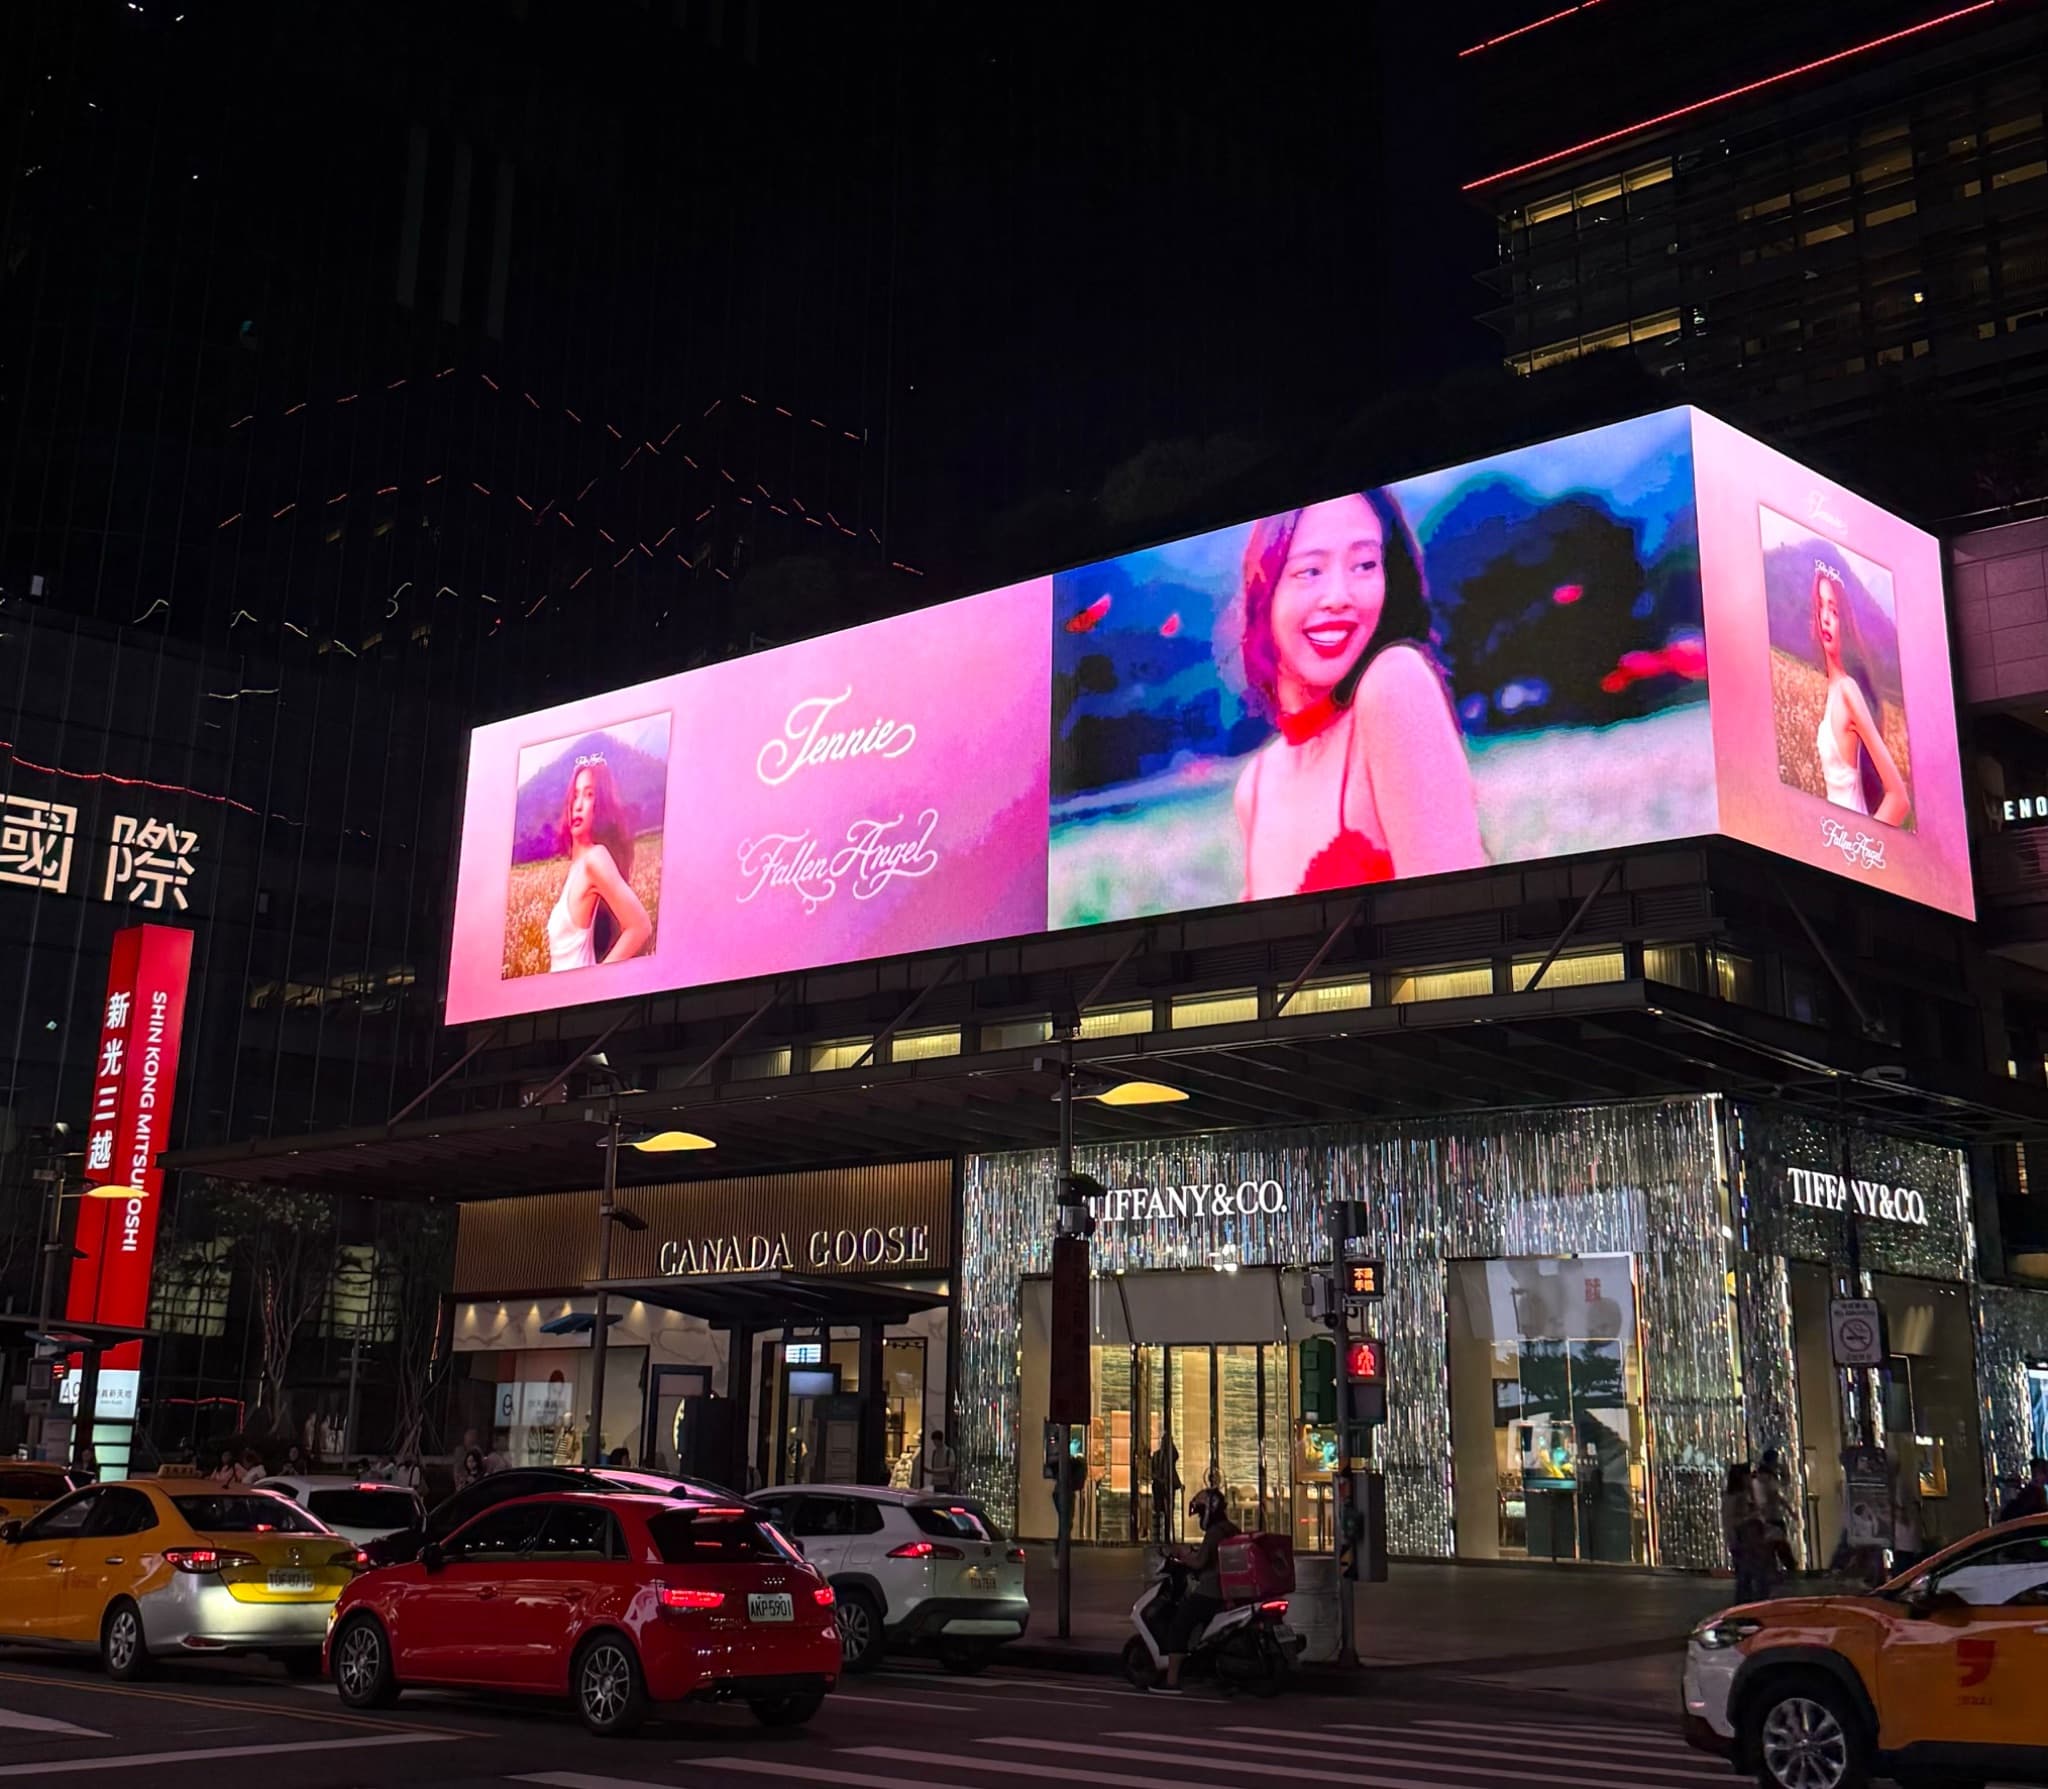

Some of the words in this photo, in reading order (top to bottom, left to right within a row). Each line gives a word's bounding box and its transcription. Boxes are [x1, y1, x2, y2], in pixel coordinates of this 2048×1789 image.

[757, 684, 916, 784] Jennie
[0, 794, 198, 909] 國際
[736, 829, 836, 915] Fallen
[830, 808, 939, 900] Angel
[147, 991, 168, 1043] SHIN
[87, 991, 130, 1170] 新光三越
[139, 1047, 162, 1109] KONG
[122, 1114, 153, 1252] MITSUOSHI
[659, 1235, 795, 1276] CANADA
[809, 1225, 929, 1268] GOOSE
